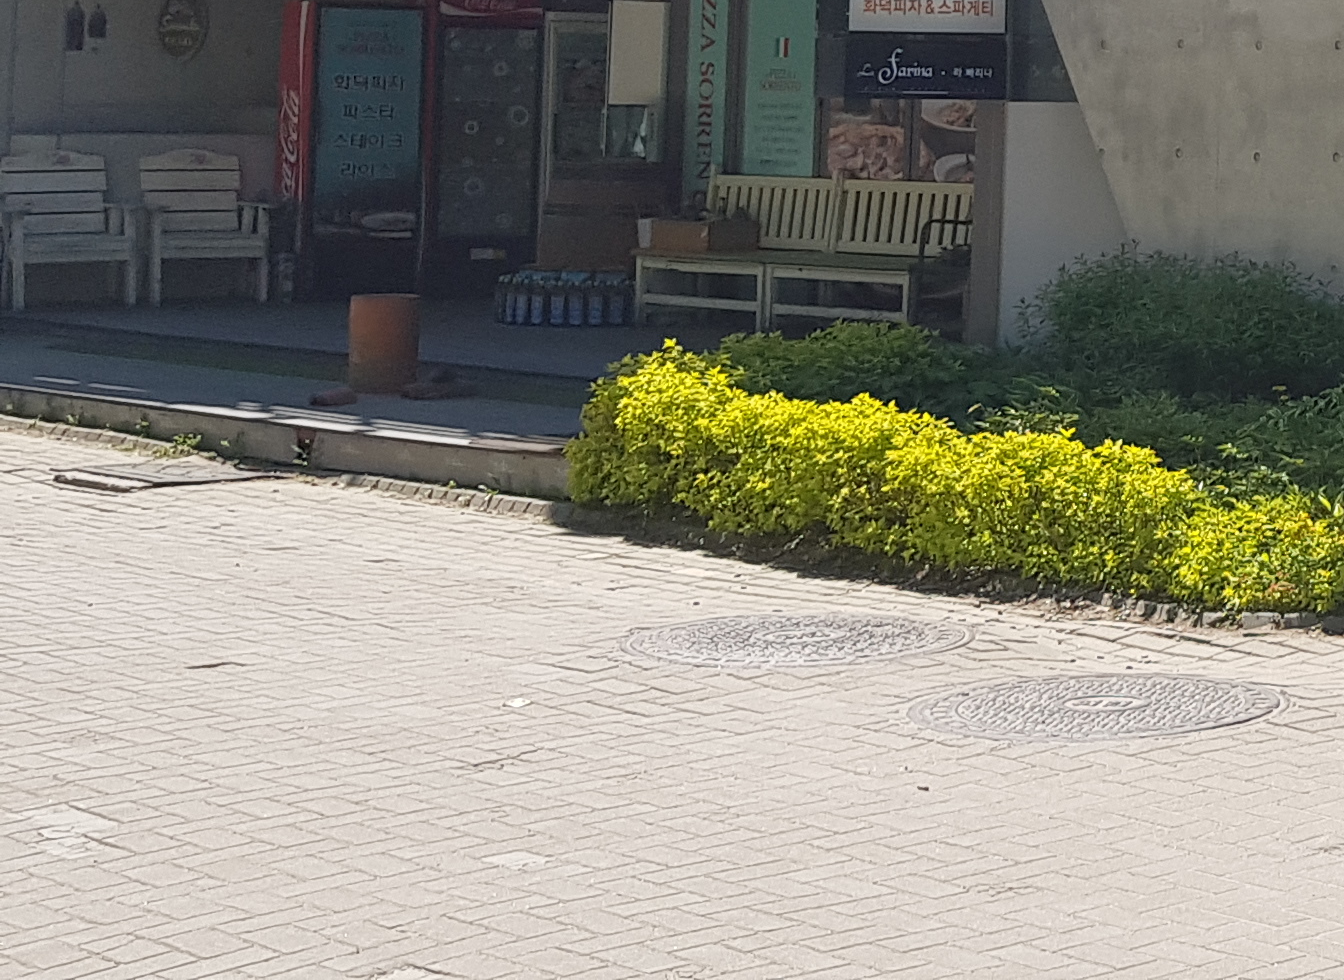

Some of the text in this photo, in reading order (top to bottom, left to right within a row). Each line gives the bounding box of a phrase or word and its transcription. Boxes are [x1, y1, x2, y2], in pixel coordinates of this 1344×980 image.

[342, 103, 395, 121] 파스타
[333, 132, 404, 150] 스테이크
[339, 161, 396, 180] 라이스
